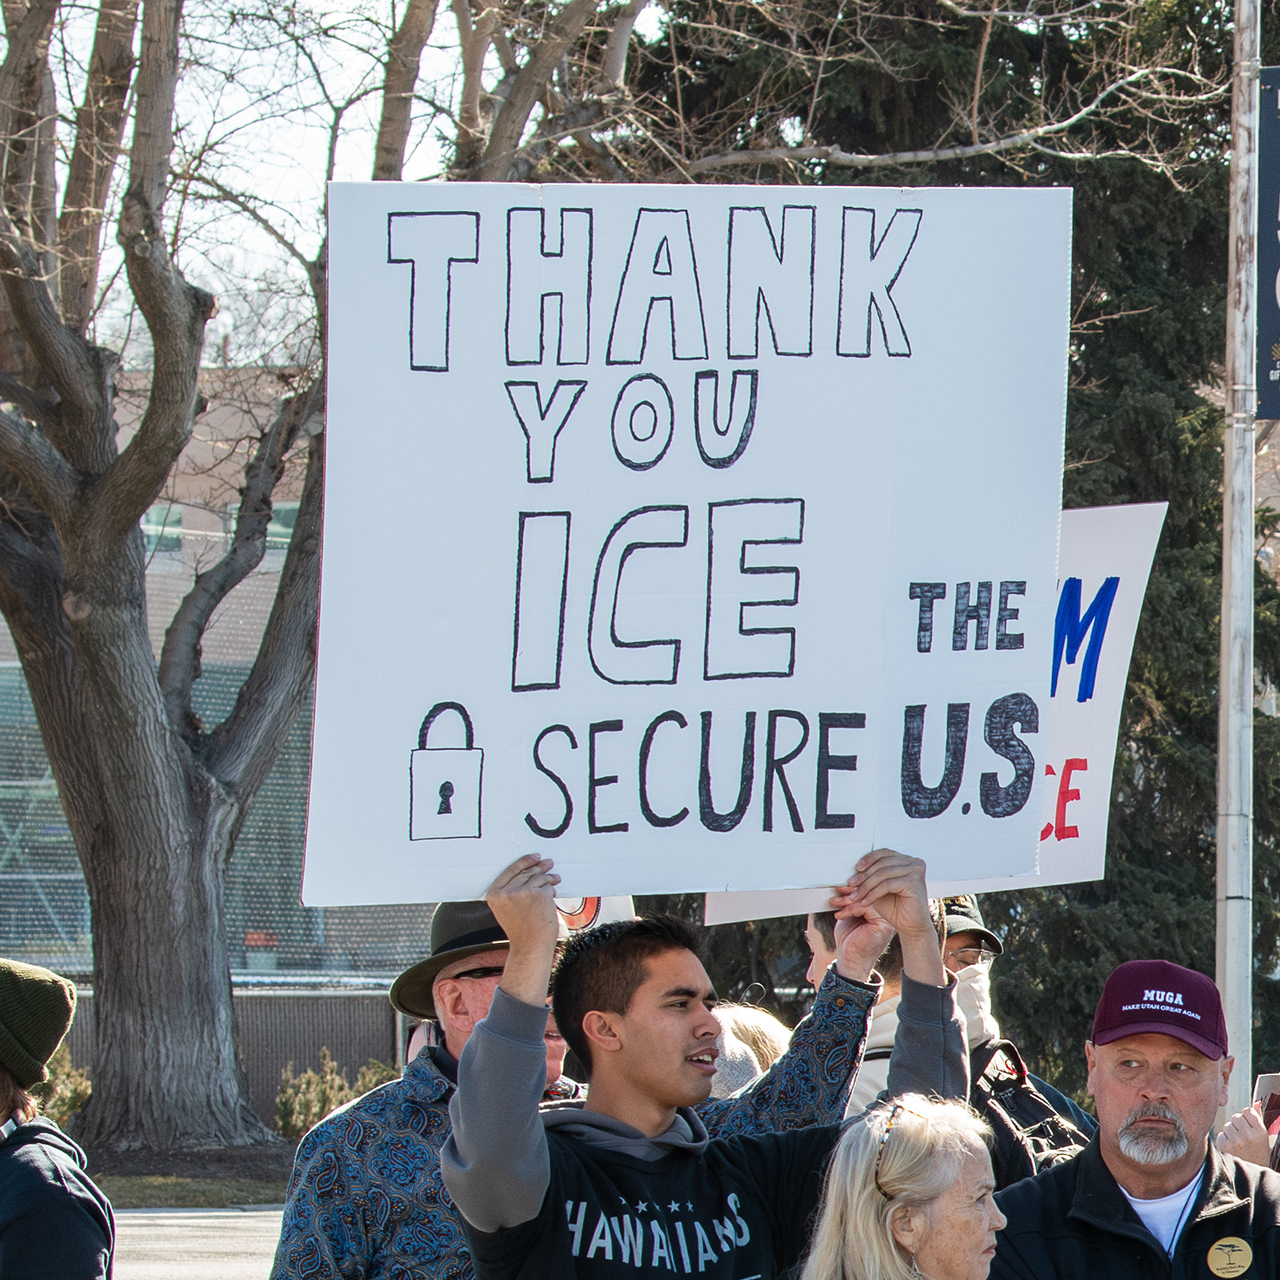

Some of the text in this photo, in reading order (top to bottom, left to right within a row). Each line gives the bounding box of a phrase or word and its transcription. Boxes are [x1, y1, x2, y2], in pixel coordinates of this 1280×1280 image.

[387, 205, 923, 372] THANK
[504, 369, 758, 483] YOU
[511, 497, 805, 692] ICE
[908, 580, 1026, 653] THE
[524, 692, 1040, 838] SECURE U.S
[1122, 1003, 1140, 1011] MAKE
[1160, 1005, 1182, 1014] GREAT
[1143, 990, 1184, 1006] MUGA
